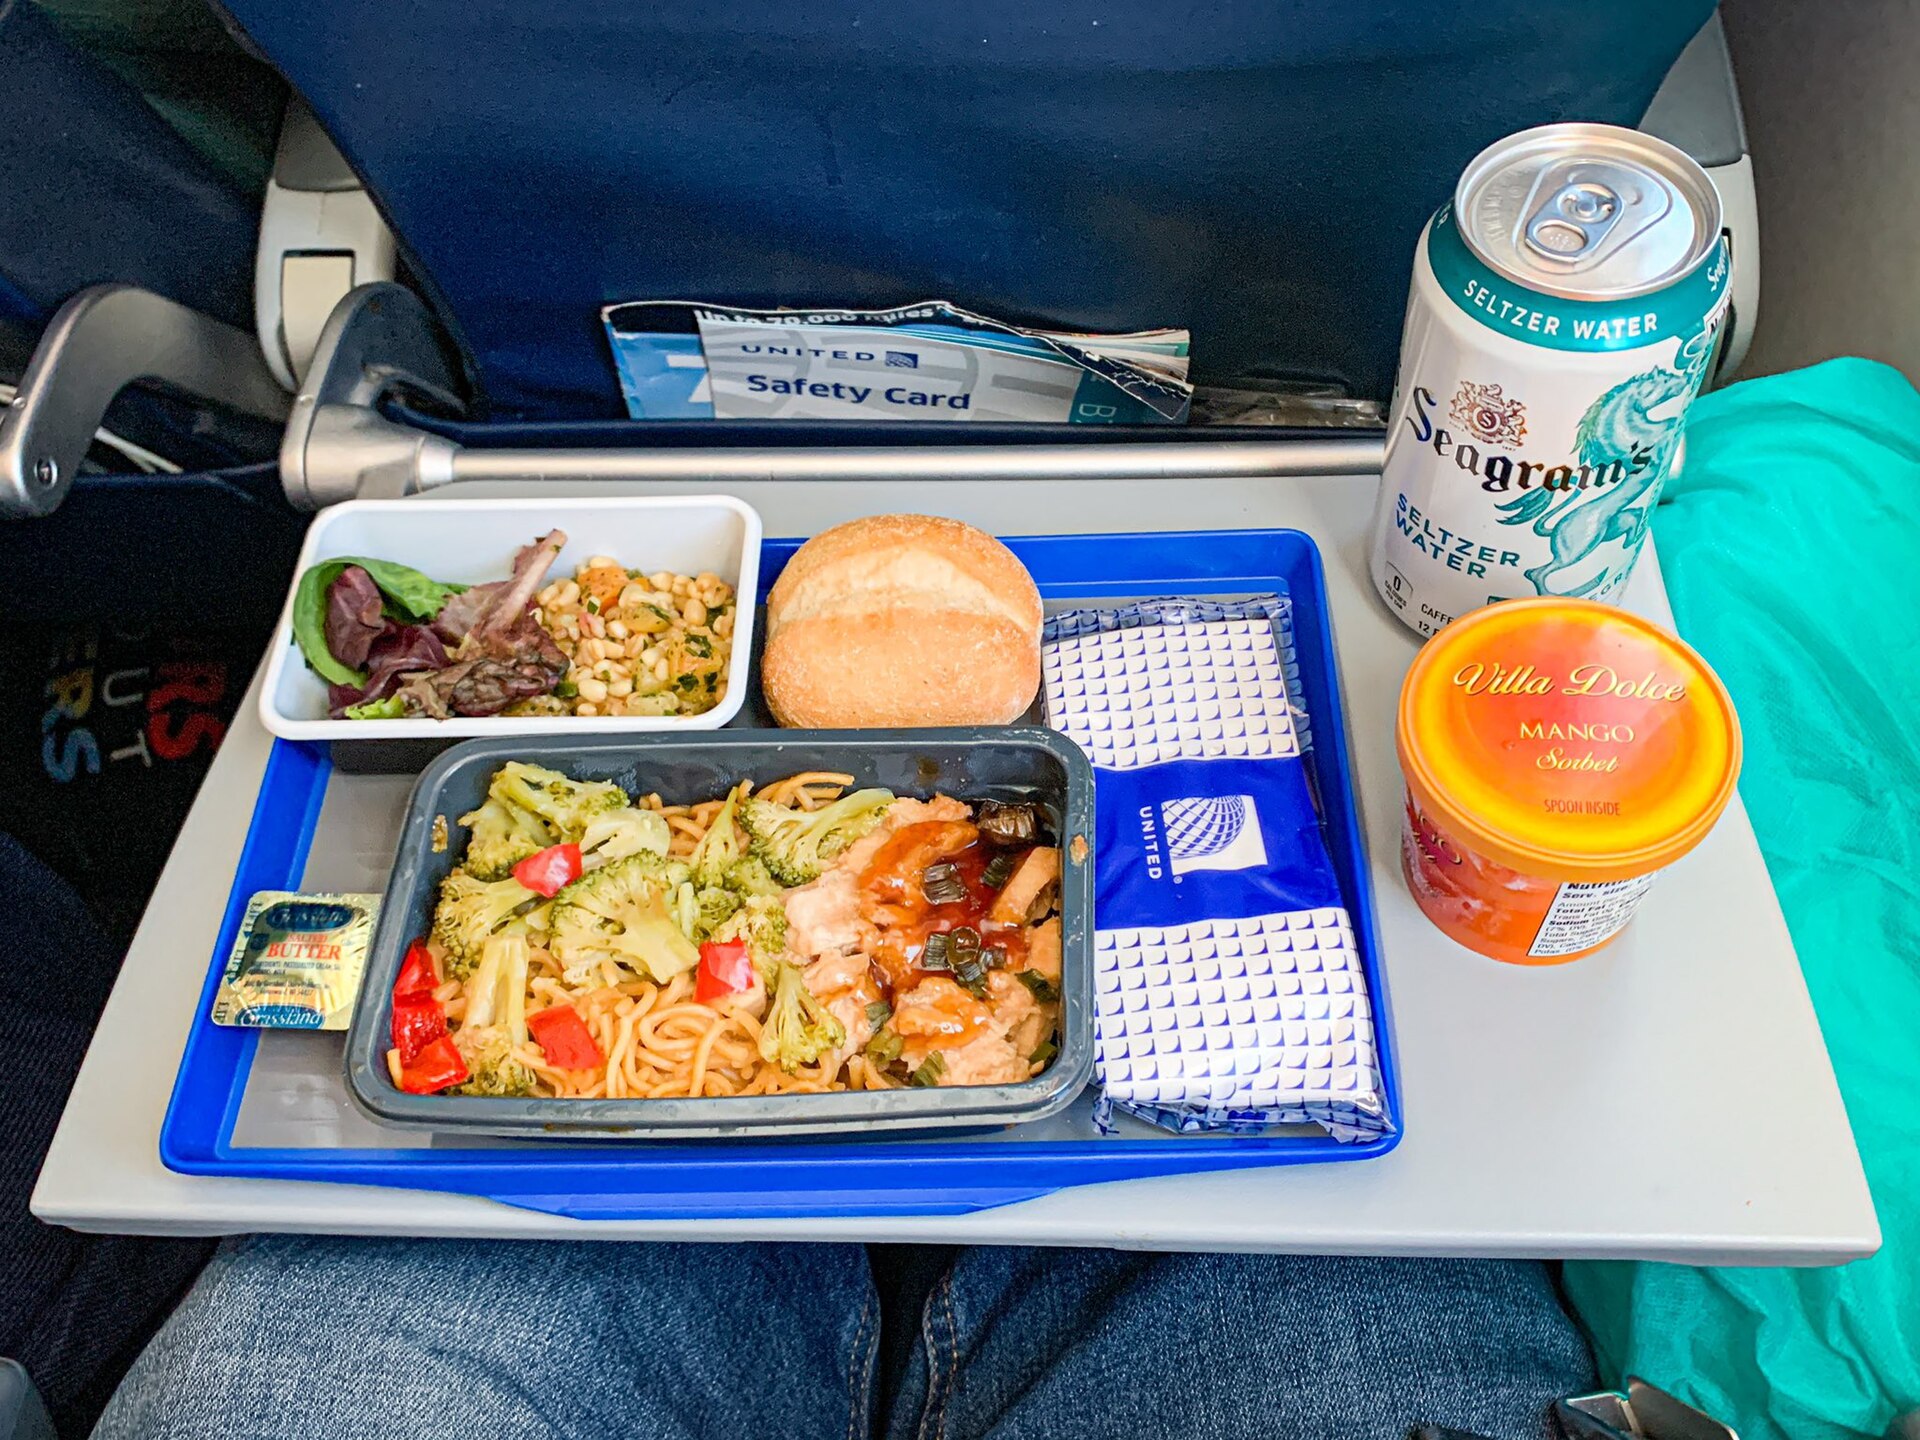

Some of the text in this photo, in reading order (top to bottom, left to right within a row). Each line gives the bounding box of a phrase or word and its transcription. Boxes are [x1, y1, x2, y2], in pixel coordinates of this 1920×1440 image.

[1463, 279, 1658, 340] SELTZER WATER
[740, 344, 876, 362] UNITED
[745, 374, 972, 410] Safety Card
[1405, 386, 1655, 493] Seagram's
[1394, 508, 1488, 579] WATER
[1397, 493, 1521, 568] SELTZER
[1420, 603, 1456, 626] CAFFE
[1452, 661, 1687, 702] Villa Dolce
[1519, 721, 1636, 744] MANGO
[1535, 747, 1620, 774] Sorbet
[1543, 799, 1621, 817] SPOON INSIDE
[1139, 805, 1163, 880] UNITED
[266, 941, 342, 961] BUTTER
